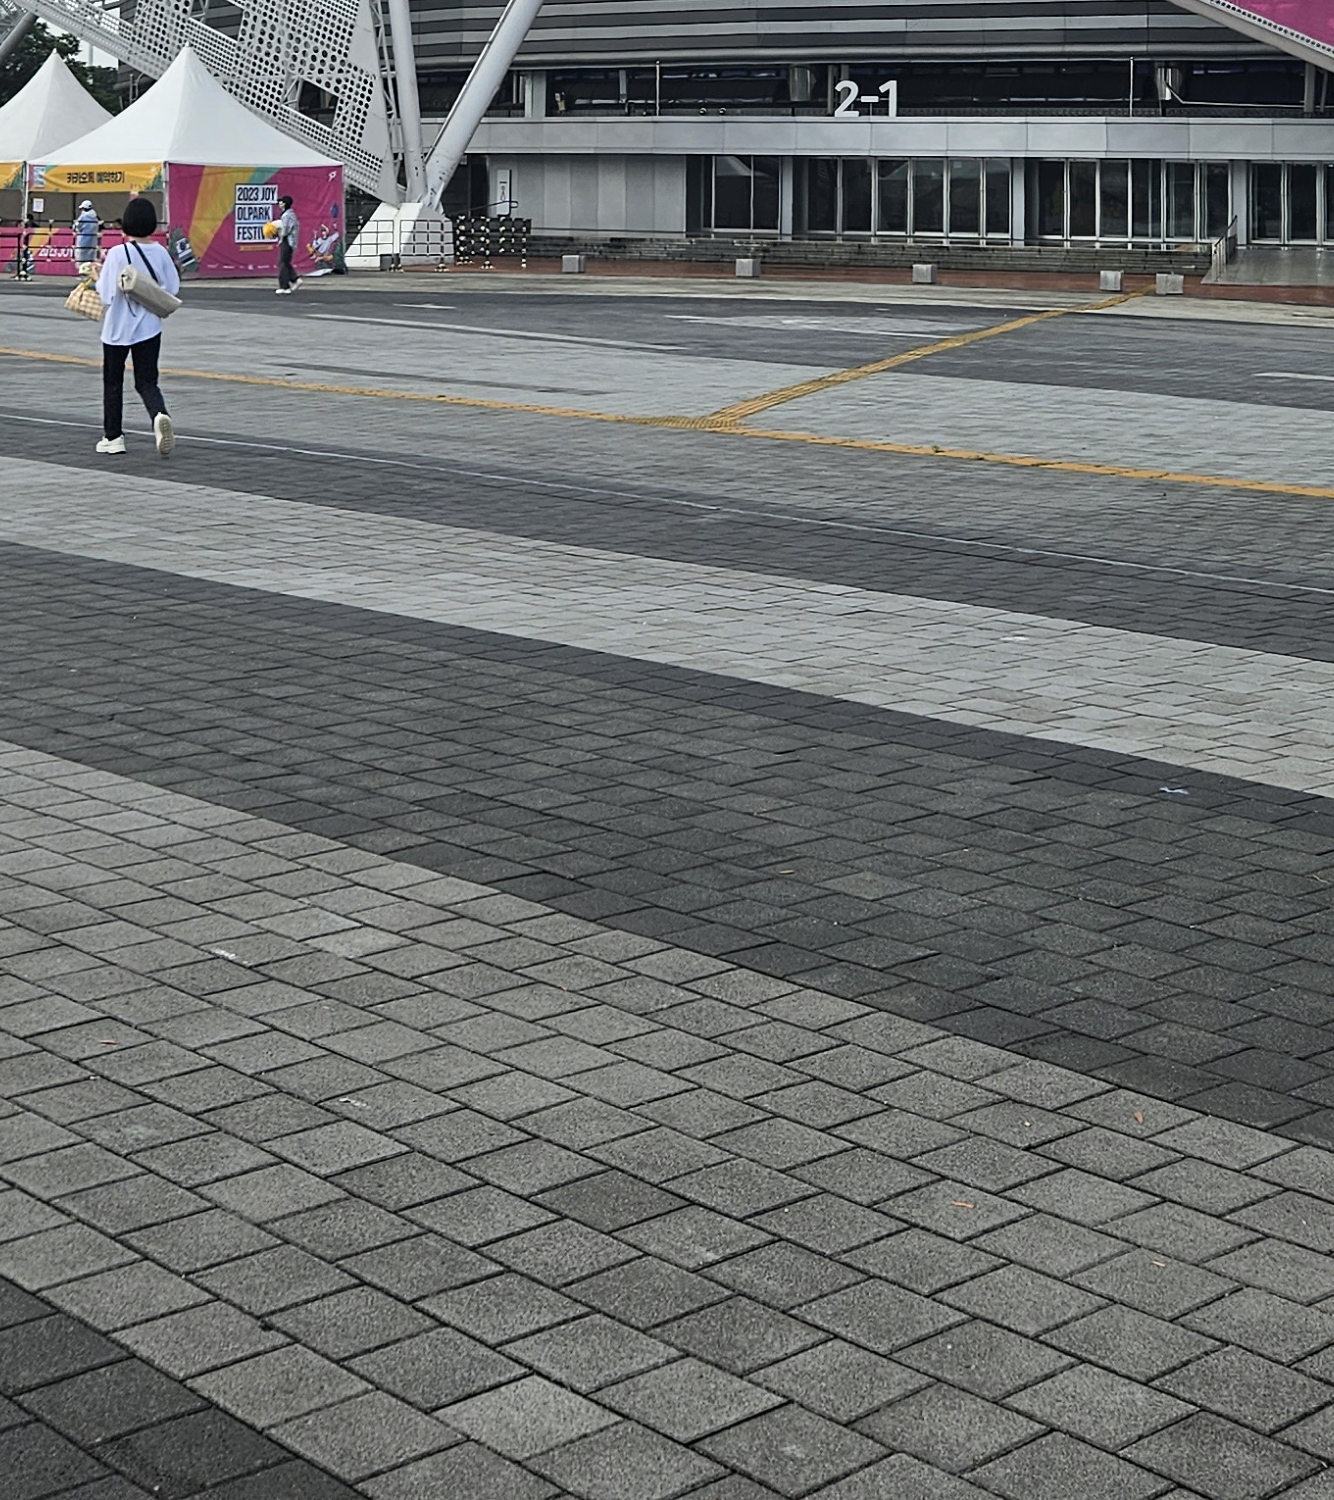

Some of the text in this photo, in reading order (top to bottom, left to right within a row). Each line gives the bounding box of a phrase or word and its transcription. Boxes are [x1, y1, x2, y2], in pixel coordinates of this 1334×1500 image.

[834, 80, 898, 117] 2-1
[237, 187, 277, 201] 2023 JOY
[237, 206, 271, 220] OLPARK
